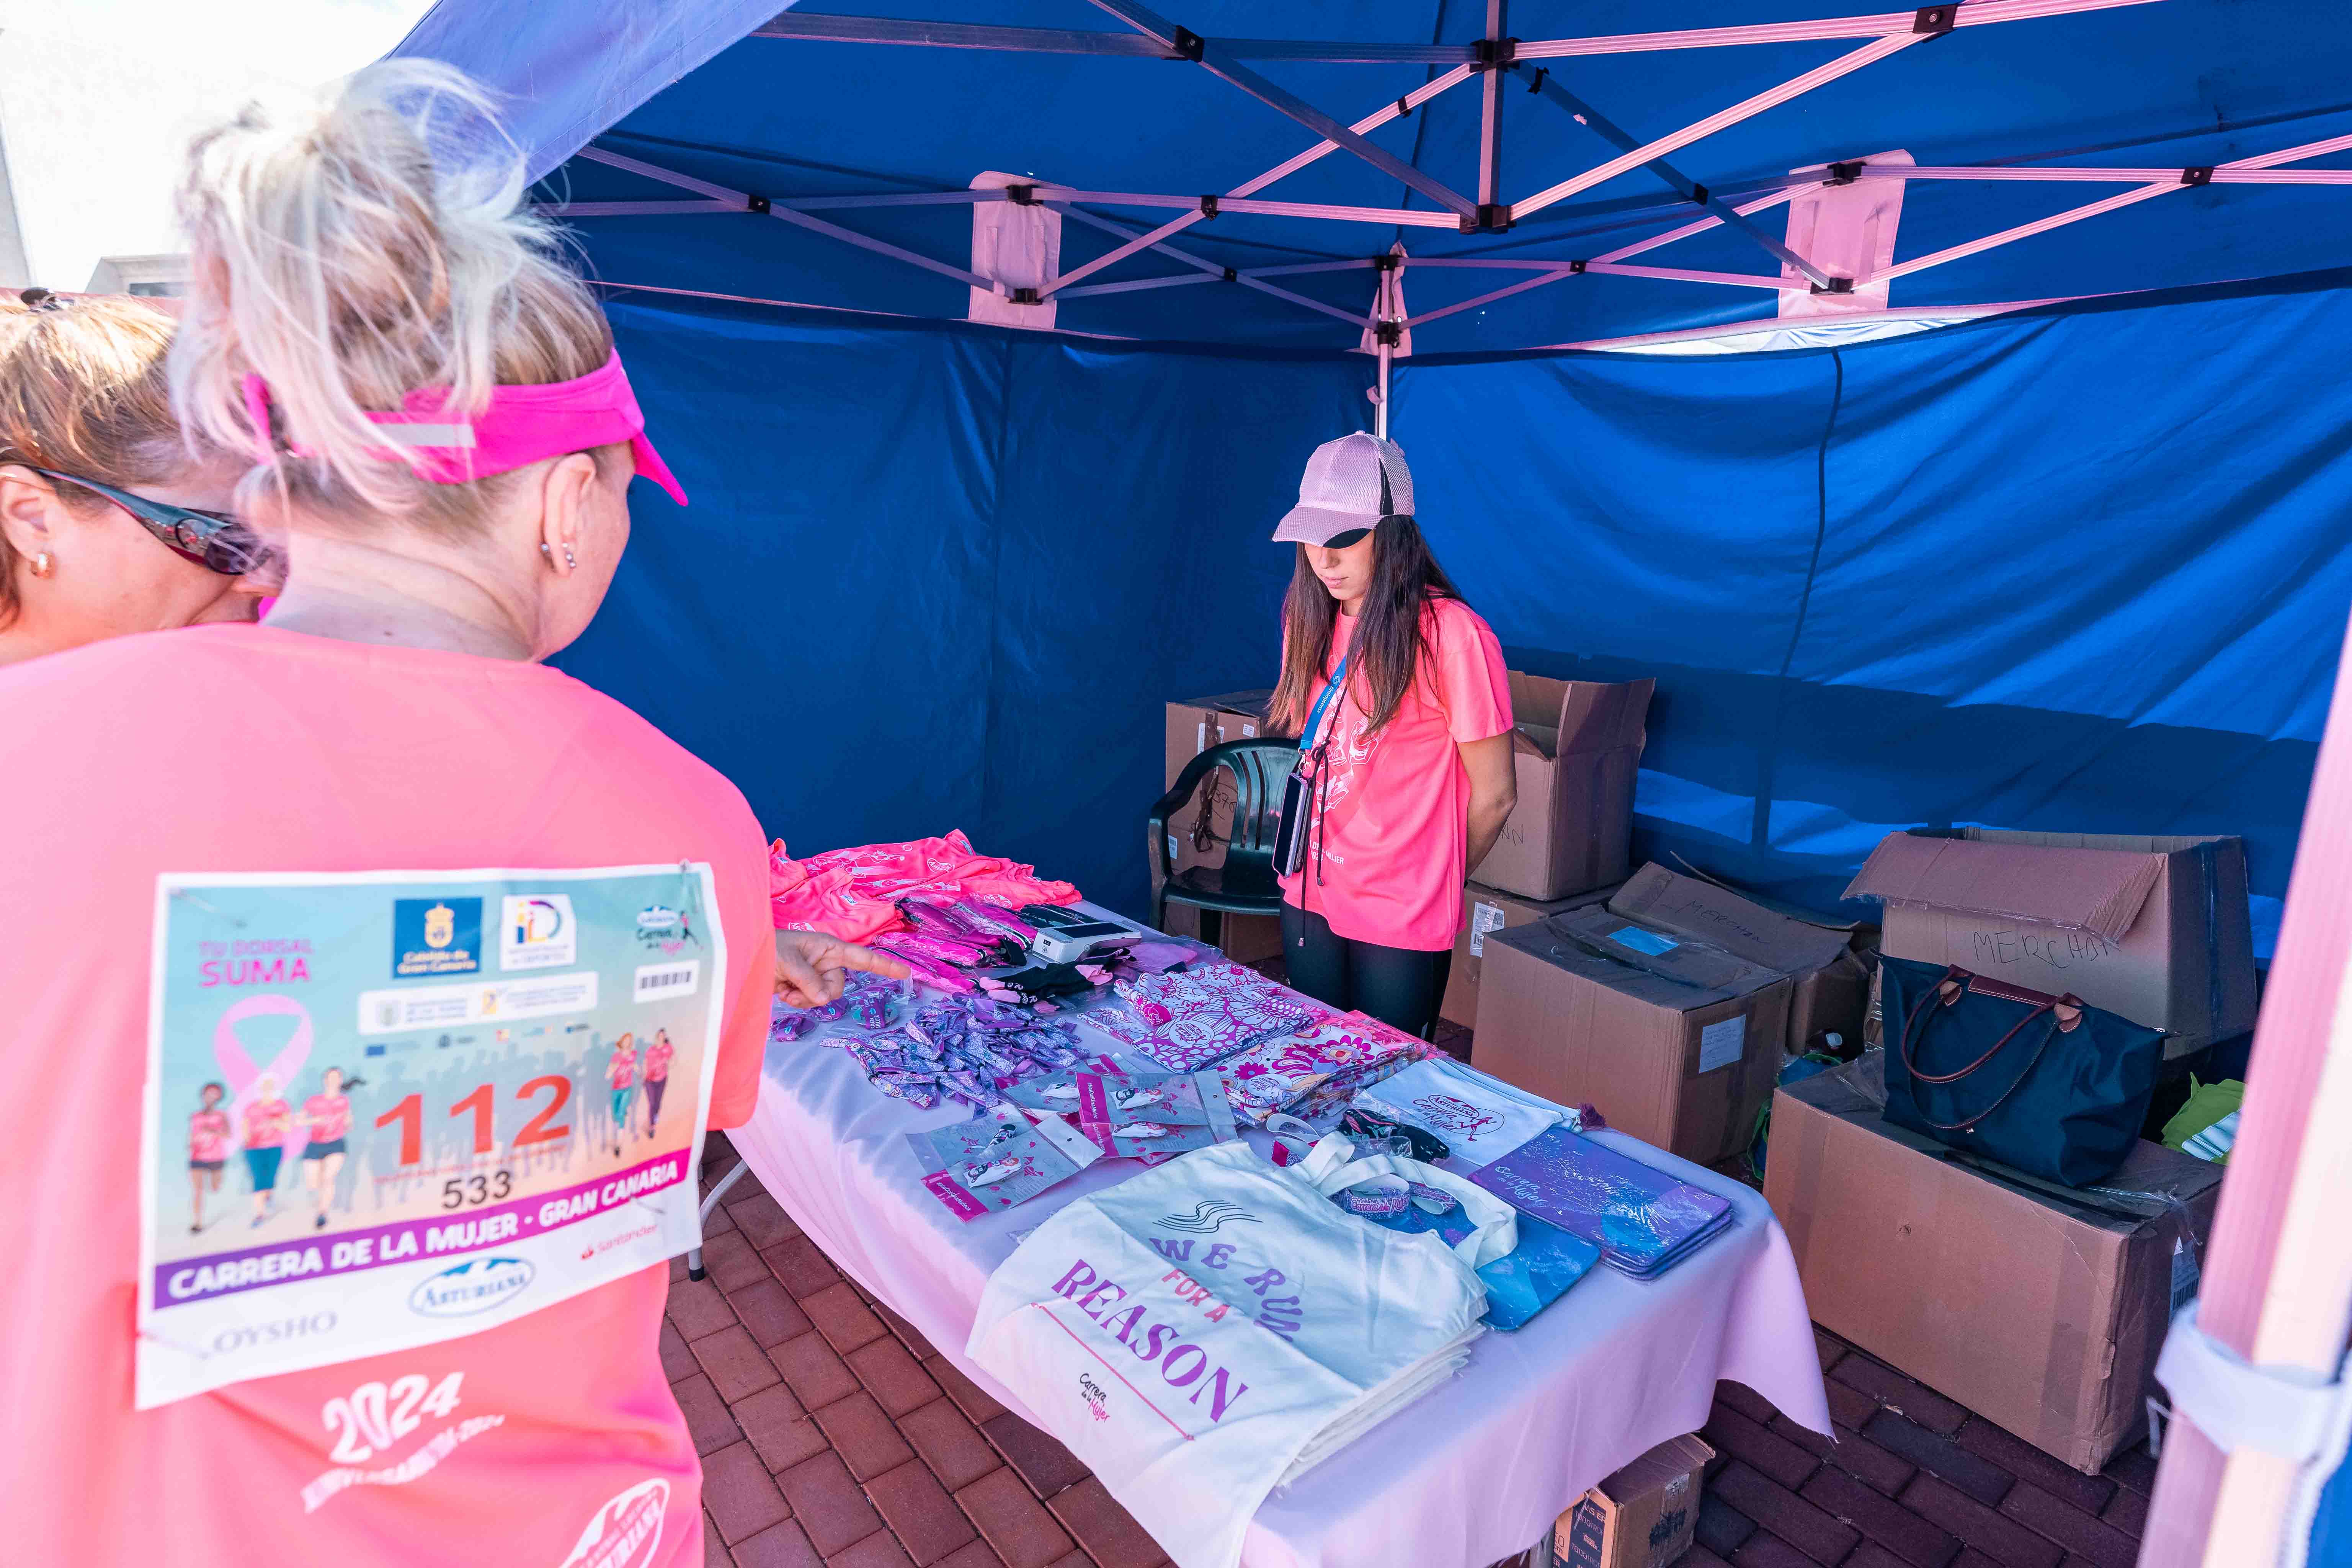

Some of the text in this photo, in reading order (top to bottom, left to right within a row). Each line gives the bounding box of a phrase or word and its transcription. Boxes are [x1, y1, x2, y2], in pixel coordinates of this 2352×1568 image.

[1317, 686, 1334, 714] timingsense
[1326, 851, 1344, 865] MUJER
[199, 939, 315, 957] TU DORSAL
[199, 958, 311, 987] SUMA
[374, 1075, 571, 1166] 112
[1413, 1099, 1457, 1120] Carrera
[1432, 1097, 1474, 1117] ASTURIANA
[443, 1171, 511, 1208] 533
[1495, 1166, 1541, 1191] Carrera
[1351, 1199, 1378, 1213] Carrera
[1389, 1193, 1410, 1217] Mujer
[1504, 1184, 1548, 1204] Mujer
[168, 1247, 323, 1298] CARRERA
[331, 1239, 373, 1269] DE
[379, 1231, 418, 1260] LA
[425, 1212, 518, 1253] MUJER
[539, 1191, 598, 1227] GRAN
[601, 1161, 678, 1206] CANARIA
[598, 1225, 658, 1254] Santander
[1149, 1237, 1303, 1342] WE RUN
[1161, 1268, 1231, 1323] FOR A
[214, 1311, 337, 1353] OYSHO
[1051, 1258, 1249, 1423] REASON
[1080, 1373, 1107, 1403] Carrera
[322, 1371, 464, 1463] 2024
[1088, 1397, 1111, 1423] Mujer
